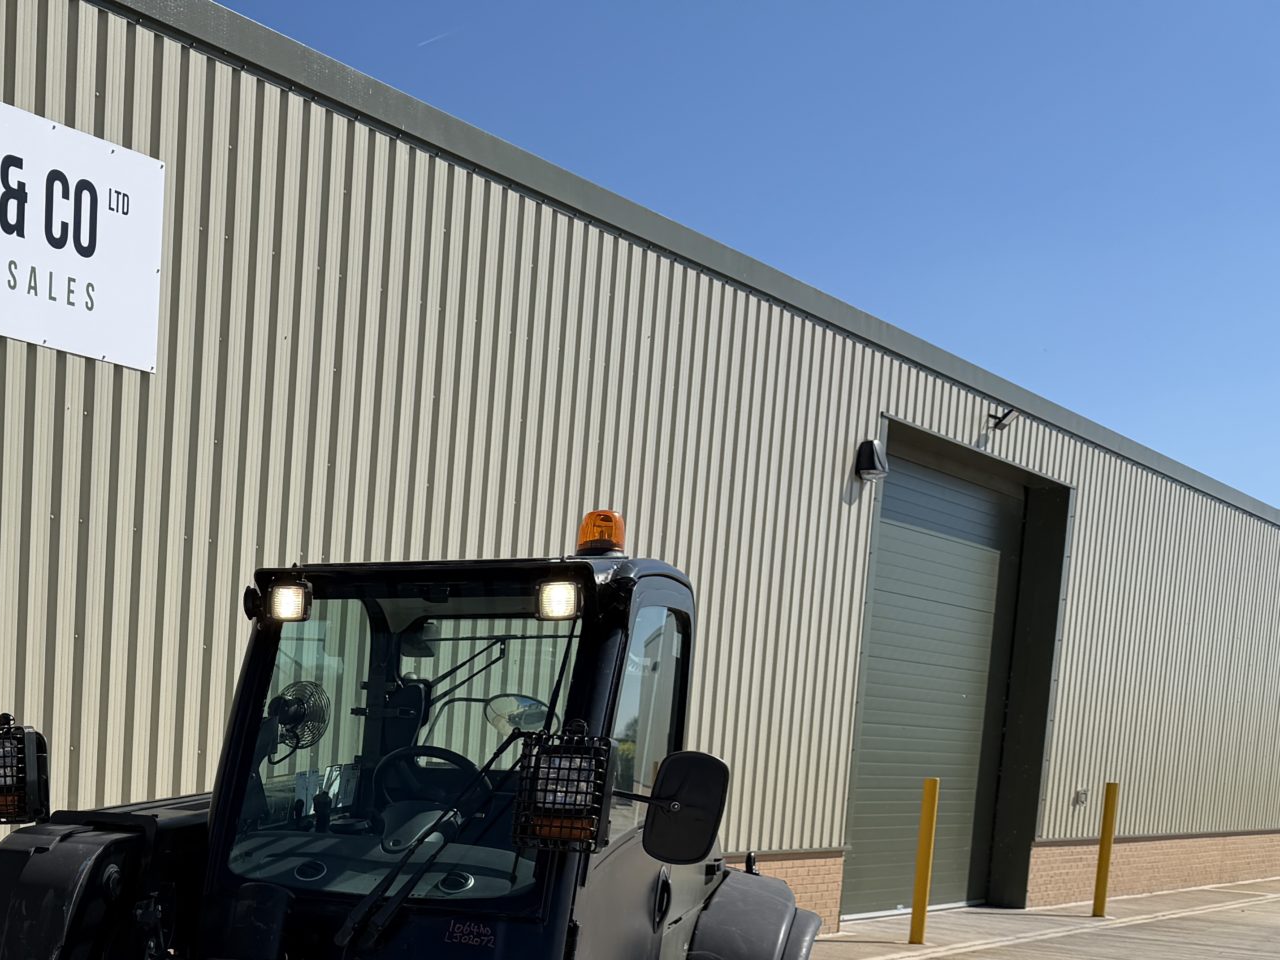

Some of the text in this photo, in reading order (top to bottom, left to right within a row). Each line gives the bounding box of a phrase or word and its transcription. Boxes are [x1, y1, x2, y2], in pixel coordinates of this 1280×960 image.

[44, 168, 99, 259] CO
[108, 187, 130, 217] LTD
[6, 259, 96, 313] SALES
